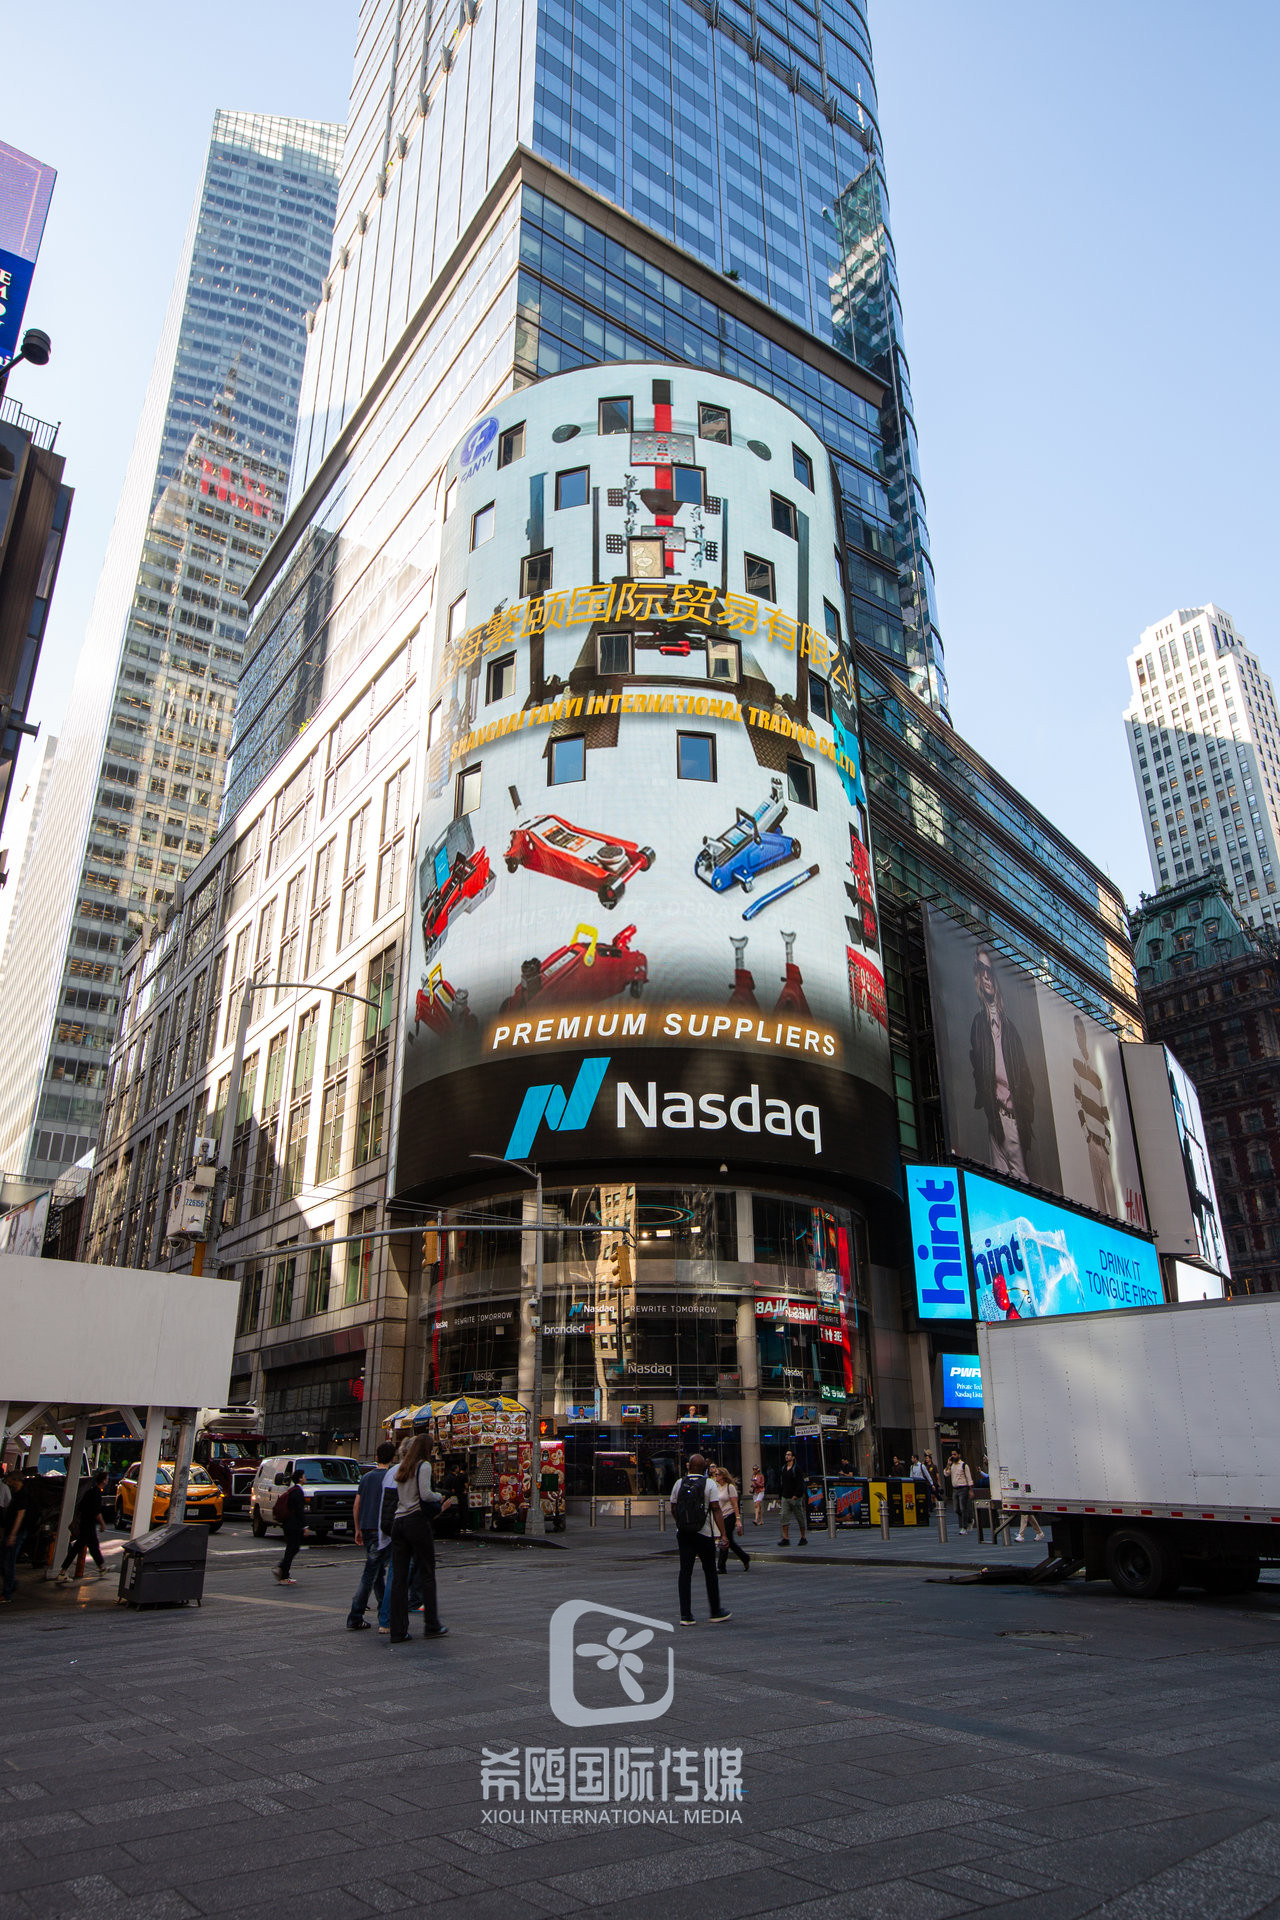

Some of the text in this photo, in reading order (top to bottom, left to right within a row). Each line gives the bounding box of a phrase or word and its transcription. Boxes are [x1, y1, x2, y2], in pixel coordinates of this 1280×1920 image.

[460, 449, 494, 483] FANYI
[450, 711, 527, 763] SHANGHAI
[528, 697, 583, 727] FANYI
[585, 694, 744, 722] INTERNATIONAL
[749, 706, 816, 750] TRADING
[493, 1013, 836, 1056] PREMIUM SUPPLIERS
[617, 1081, 822, 1154] Nasdaq
[1125, 1187, 1145, 1228] H&M
[917, 1179, 966, 1304] hint
[971, 1233, 1024, 1290] hint
[1099, 1249, 1140, 1282] DRINK IT
[1086, 1270, 1157, 1306] TONGUE FIRST
[477, 1311, 512, 1322] TOMORROW
[583, 1304, 718, 1314] Nasdaq REWRITE TOMORROW
[628, 1363, 672, 1376] Nasdaq
